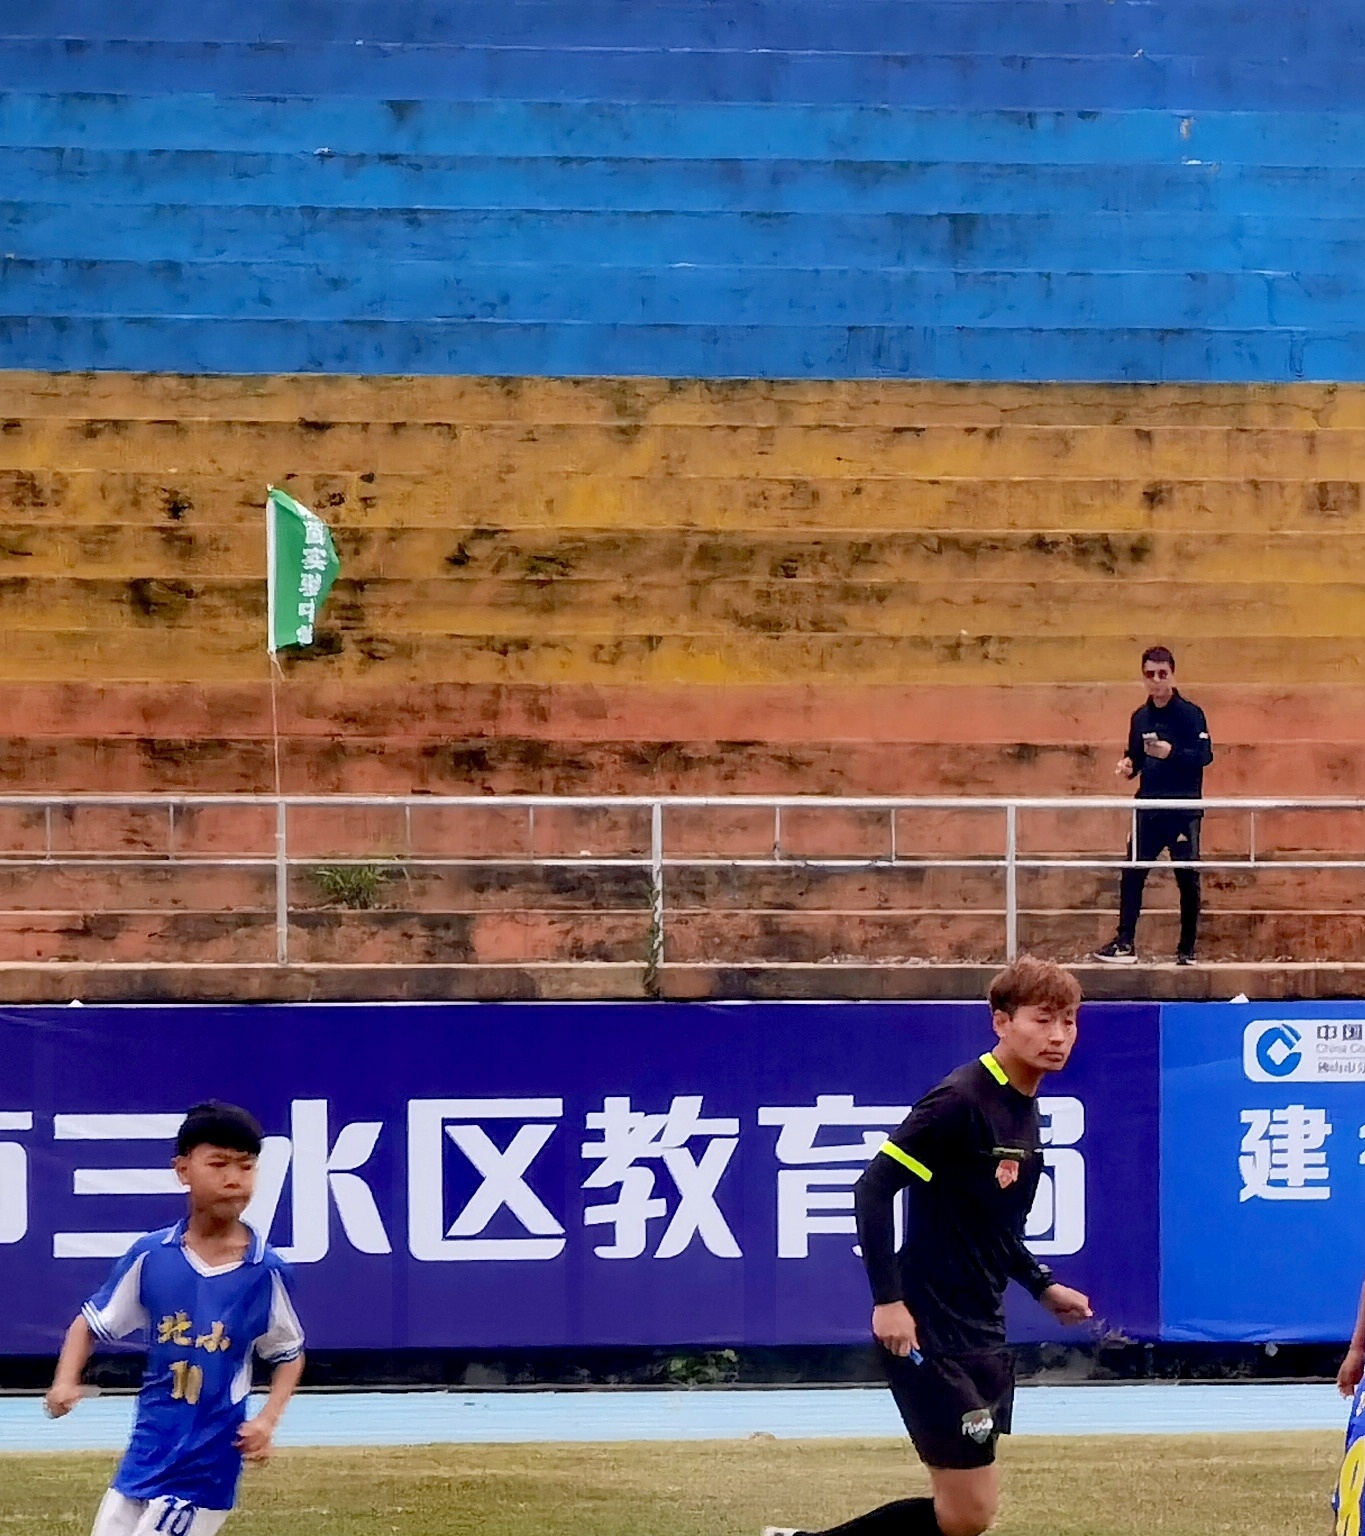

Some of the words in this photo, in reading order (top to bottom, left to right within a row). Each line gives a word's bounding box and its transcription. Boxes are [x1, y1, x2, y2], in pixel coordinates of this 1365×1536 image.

[0, 1094, 1086, 1263] 三水区教育
[157, 1309, 231, 1353] 北小
